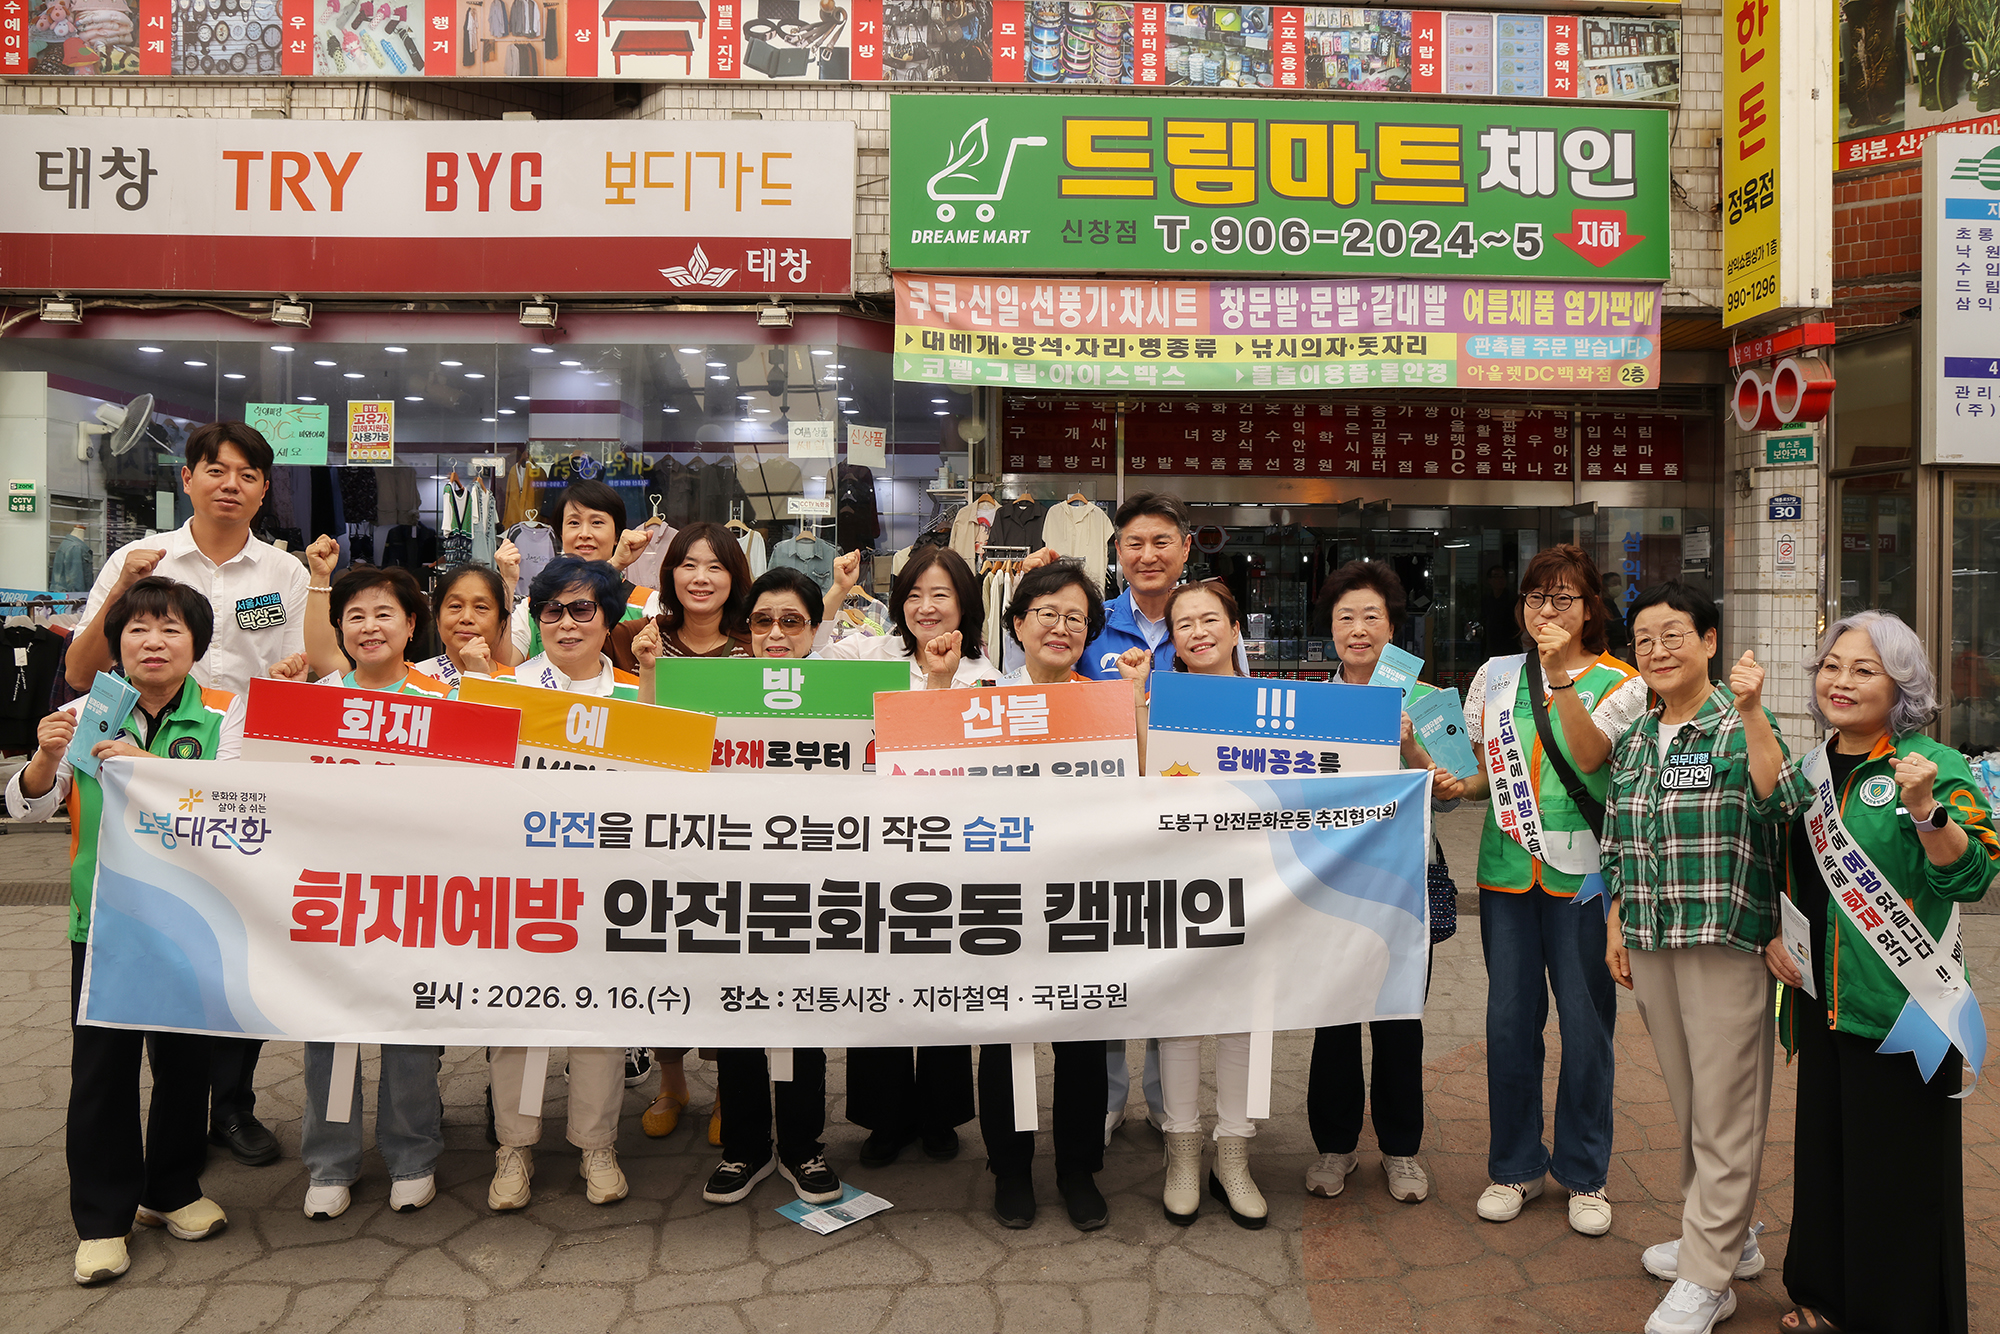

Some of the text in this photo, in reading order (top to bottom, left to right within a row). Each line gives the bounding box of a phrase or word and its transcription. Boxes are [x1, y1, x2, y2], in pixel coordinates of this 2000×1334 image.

[4, 0, 21, 66] 수예이불
[147, 15, 164, 53] 시계
[289, 15, 306, 53] 우산
[432, 15, 450, 54] 행거
[574, 27, 591, 44] 상
[858, 21, 875, 58] 가방
[1000, 22, 1017, 59] 모자
[1141, 7, 1157, 82] 컴퓨터용품
[1281, 11, 1297, 86] 스포츠용품
[1418, 28, 1434, 77] 서랍장
[1554, 25, 1570, 91] 각종액자
[1736, 0, 1769, 161] 한돈
[35, 146, 793, 212] 태창 TRY BYC 보디가드
[1058, 116, 1637, 209] 드림마트 체인
[1728, 169, 1774, 226] 정육점
[910, 228, 1031, 245] DREAME MART
[1060, 215, 1545, 260] 신창점 T.906-2024~5
[1577, 221, 1622, 248] 지하
[746, 247, 811, 284] 태창
[1727, 238, 1777, 276] 삼익쇼핑상가 1층
[1463, 288, 1653, 327] 여름제품 염가판매
[1727, 274, 1776, 312] 990-1296
[1474, 338, 1648, 359] 판촉물 주문 받습니다.
[1467, 364, 1645, 384] 아울렛DC백화점 2층
[353, 424, 389, 432] 피해지원금
[354, 413, 388, 424] 고유가
[1211, 402, 1227, 470] 화장품
[353, 433, 389, 442] 사용가능
[851, 429, 883, 448] 신상품
[1398, 405, 1413, 473] 가구점
[1638, 414, 1653, 475] 림마트
[1773, 448, 1807, 460] 보안구역
[11, 504, 33, 512] 녹화중
[1774, 507, 1795, 518] 30
[237, 593, 281, 611] 서울시의원
[240, 606, 284, 628] 박상근
[763, 667, 805, 709] 방
[337, 697, 433, 748] 화재
[565, 703, 609, 748] 예
[961, 693, 1050, 739] 산불
[1499, 709, 1516, 745] 관심
[1216, 746, 1341, 774] 담배꽁초를
[1487, 737, 1506, 774] 방심
[1506, 748, 1523, 777] 속에
[1669, 753, 1709, 765] 직무대행
[1495, 777, 1512, 806] 속에
[1663, 767, 1710, 787] 이길연
[211, 791, 266, 802] 문화와 경제가
[218, 803, 266, 813] 살아 숨 쉬는
[1512, 780, 1533, 819] 예방
[523, 811, 1034, 852] 안전을 다지는 오늘의 작은 습관
[1158, 801, 1397, 832] 도봉구 안전문화운동 추진협의회
[1810, 814, 1912, 967] 방심 속에 화재 있고
[1827, 818, 1849, 851] 속에
[1842, 849, 1882, 894] 예방
[1875, 891, 1934, 960] 있습니다
[289, 868, 1246, 955] 화재예방 안전문화운동 캠페인
[488, 985, 568, 1010] 2026.
[609, 984, 691, 1015] 16.(수)
[792, 985, 890, 1013] 전통시장
[913, 985, 1009, 1013] 지하철역
[1031, 983, 1128, 1012] 국립공원
